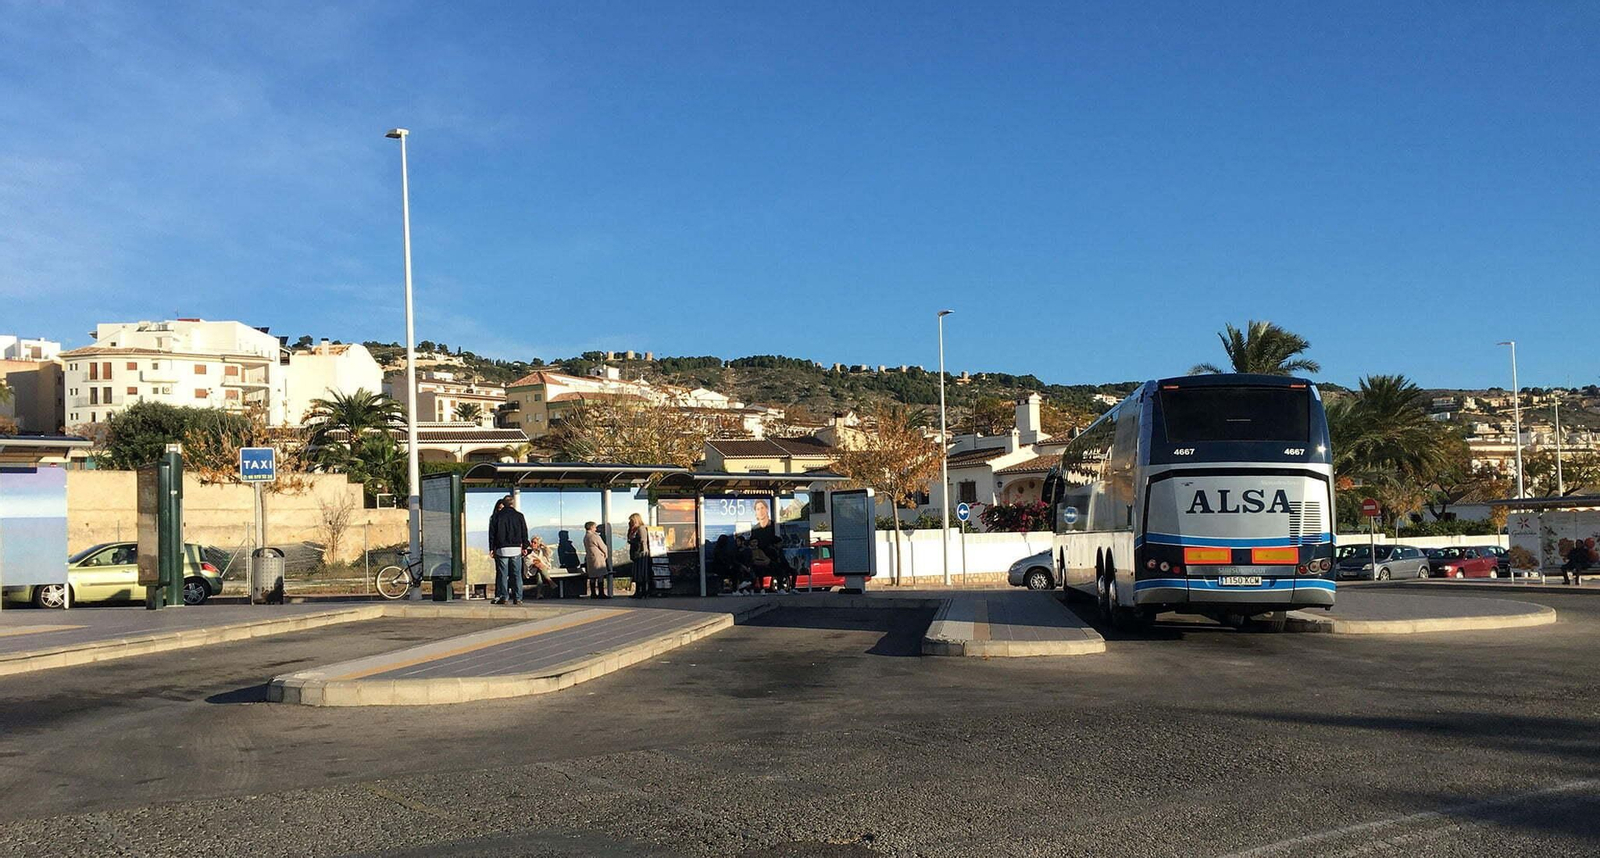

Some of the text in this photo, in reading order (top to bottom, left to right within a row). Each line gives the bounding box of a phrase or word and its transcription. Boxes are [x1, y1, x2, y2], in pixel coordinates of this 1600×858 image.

[1173, 448, 1195, 456] 4667
[1284, 448, 1305, 456] 4667
[243, 460, 272, 470] TAXI
[1186, 489, 1296, 514] ALSA
[719, 499, 746, 516] 365
